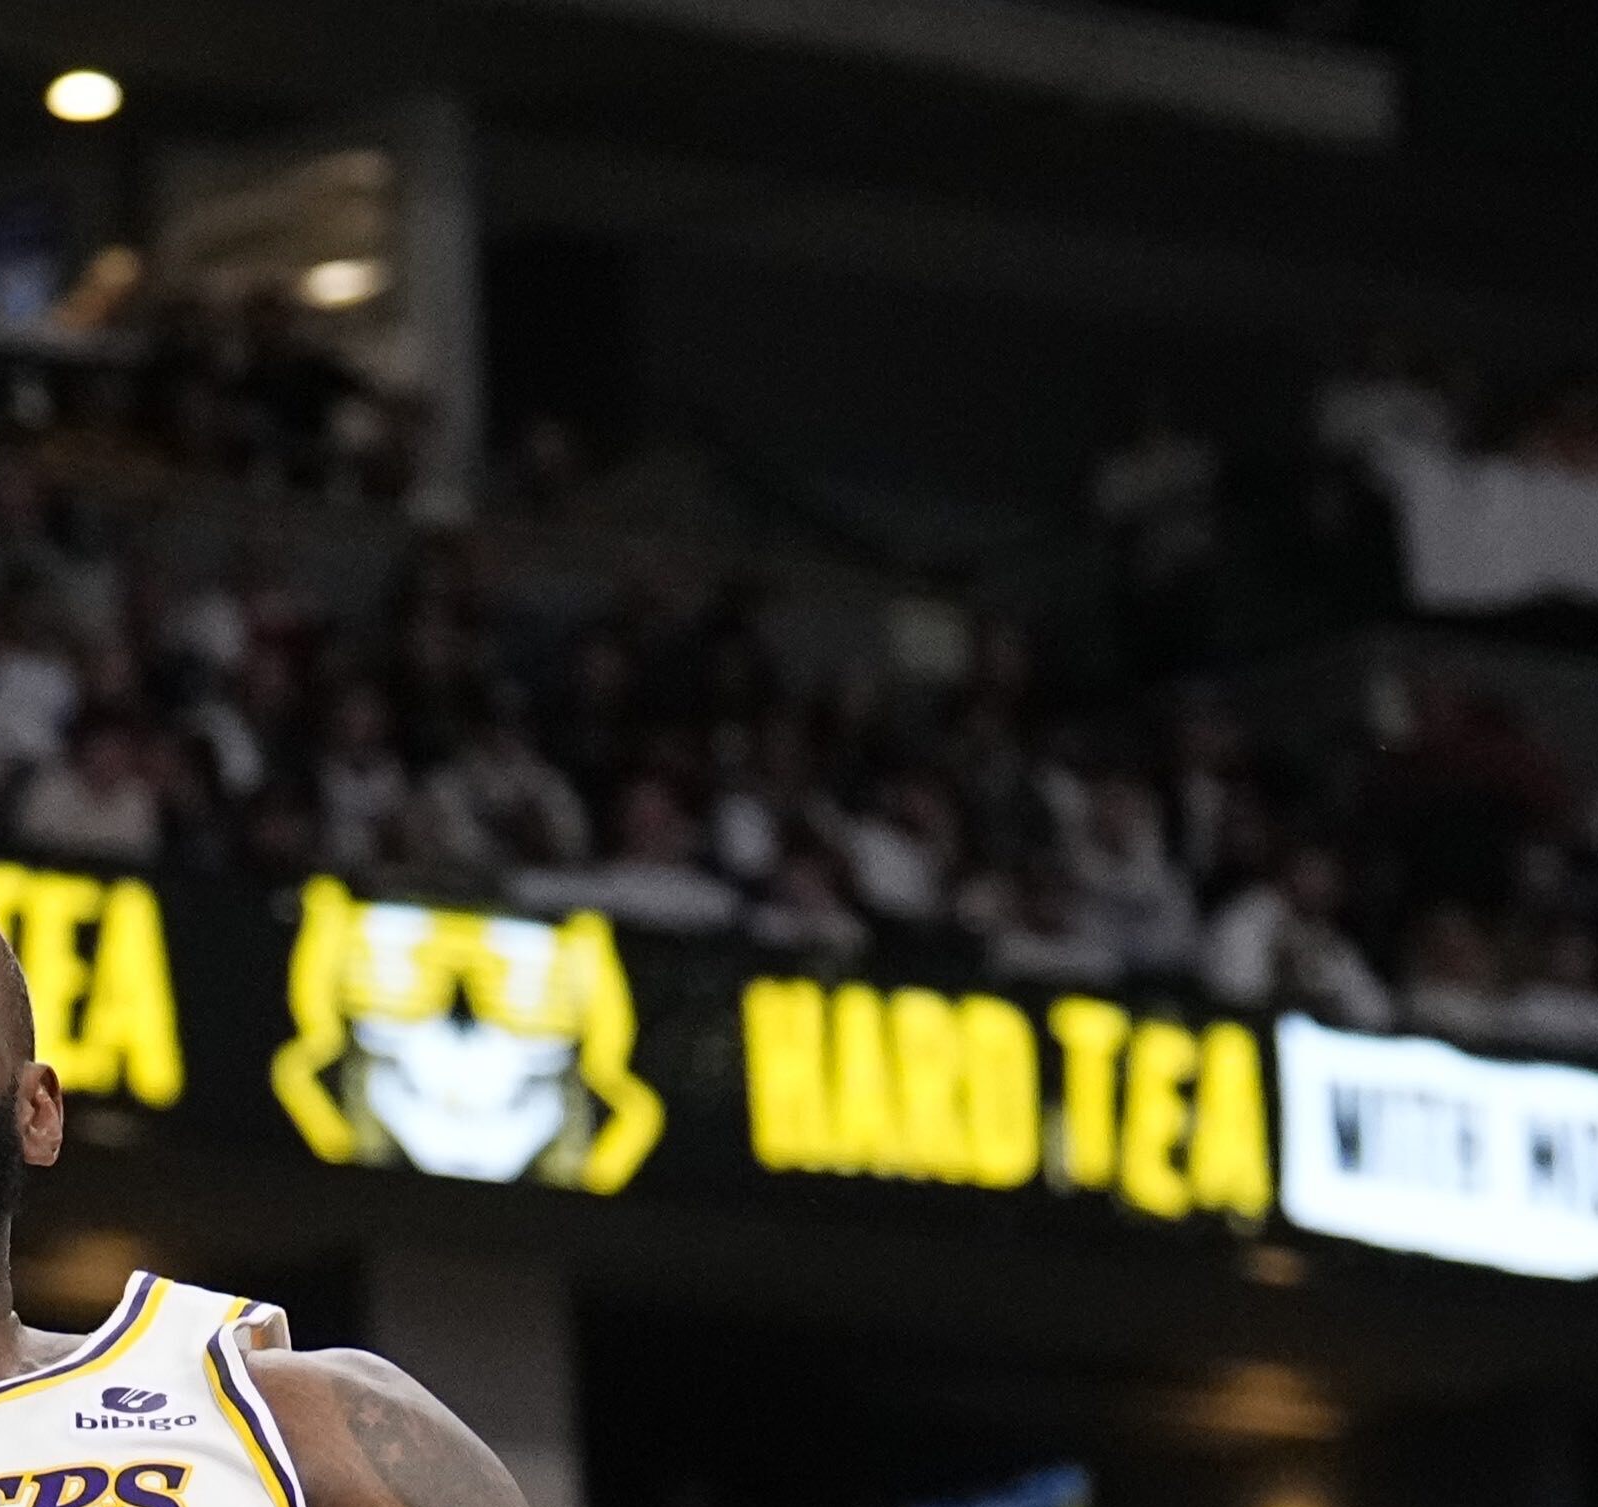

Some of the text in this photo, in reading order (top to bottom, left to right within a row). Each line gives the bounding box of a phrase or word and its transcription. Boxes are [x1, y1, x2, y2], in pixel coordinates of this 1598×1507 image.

[742, 977, 1041, 1190] HARD
[1047, 994, 1275, 1222] TEA
[75, 1411, 197, 1431] bibigo
